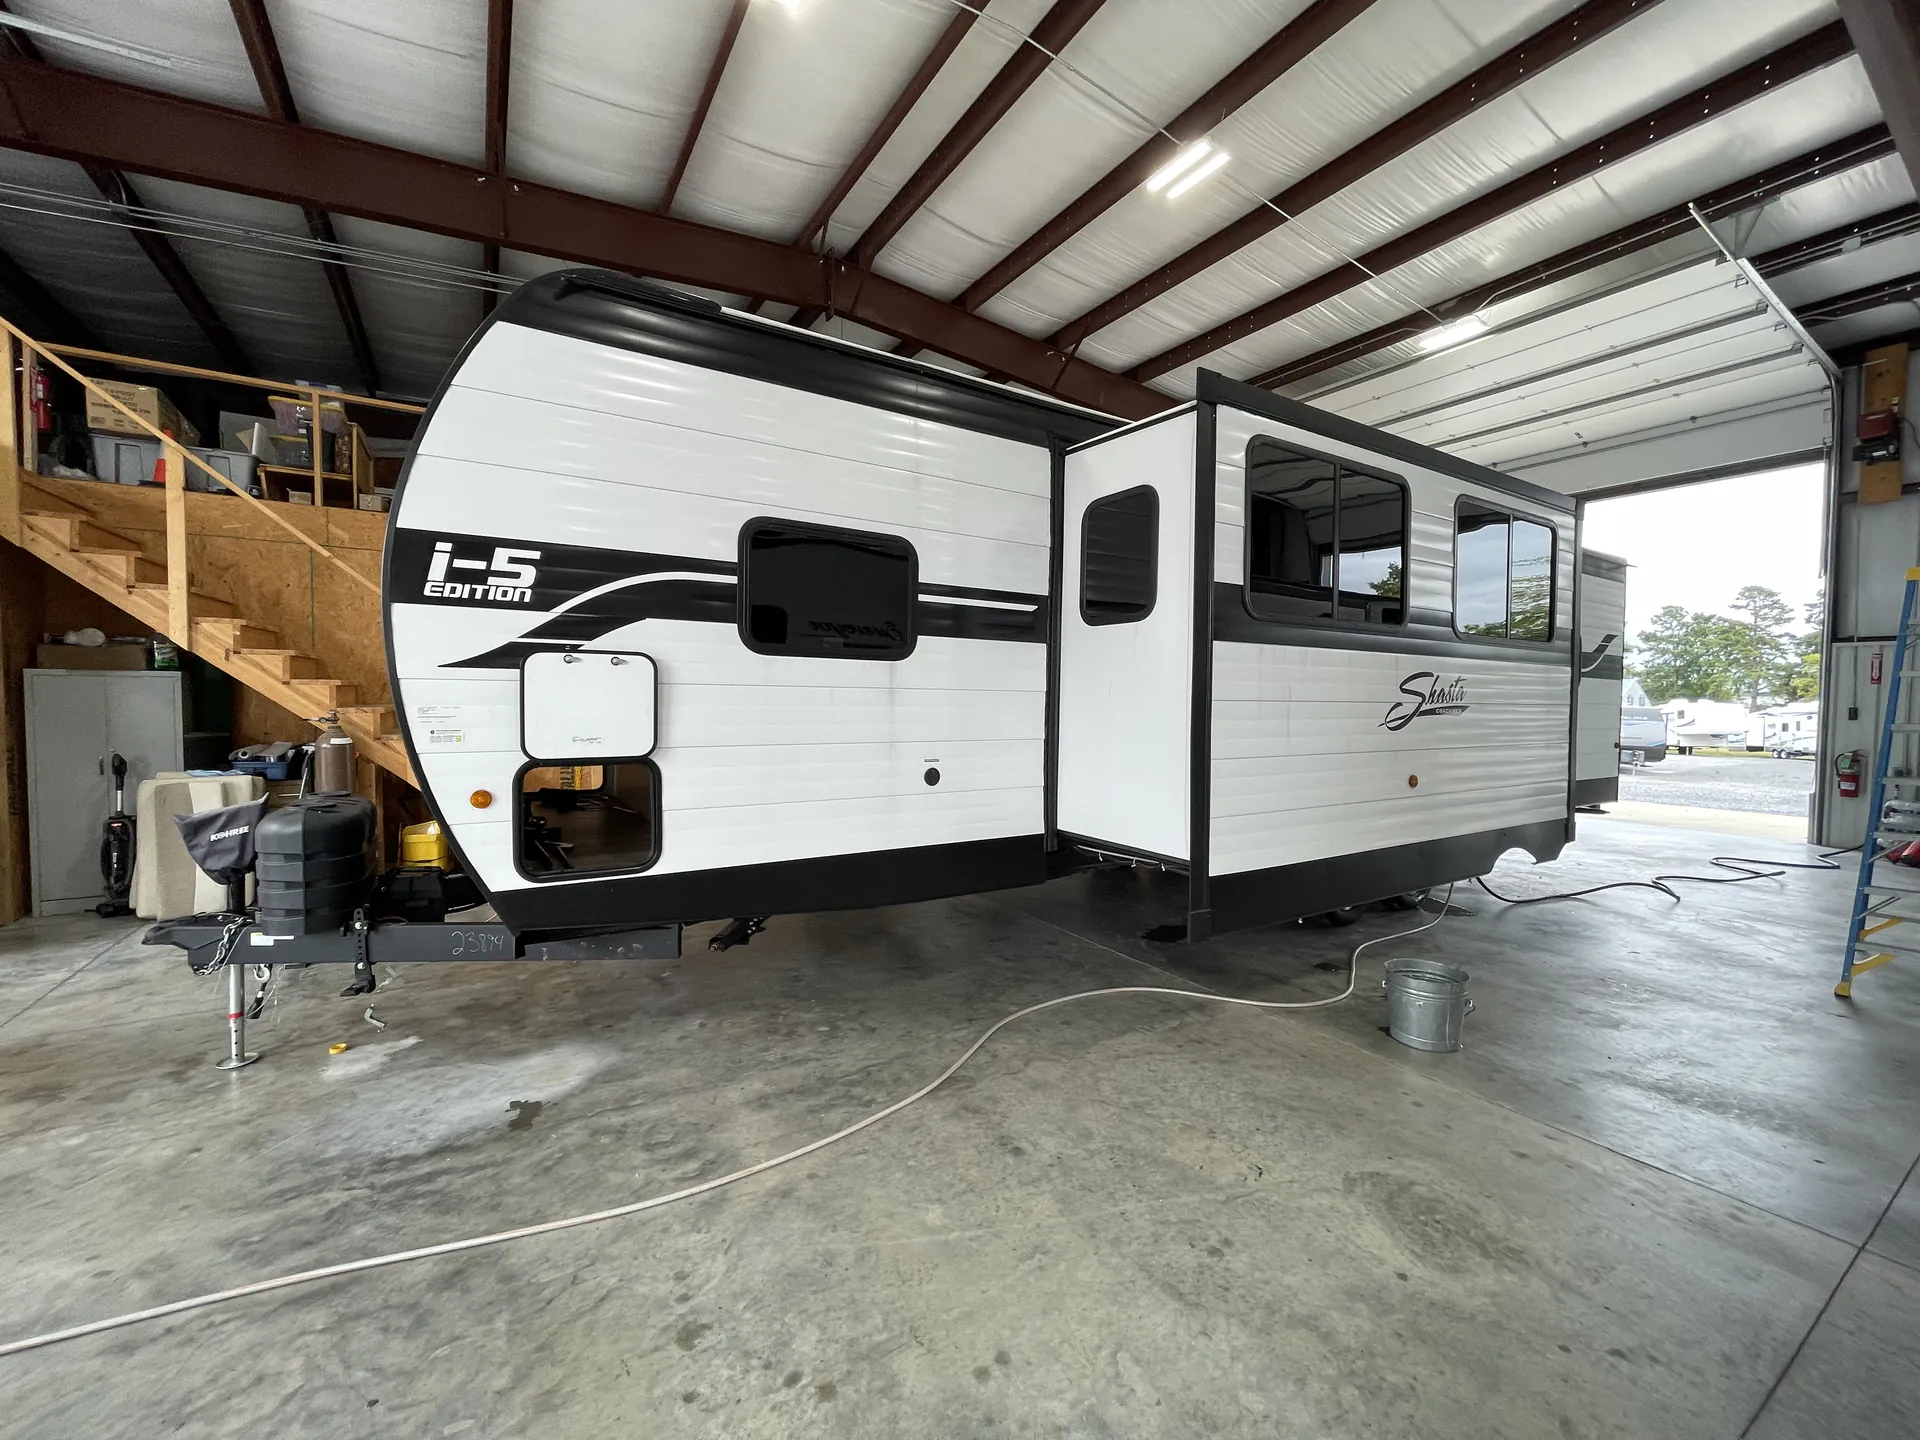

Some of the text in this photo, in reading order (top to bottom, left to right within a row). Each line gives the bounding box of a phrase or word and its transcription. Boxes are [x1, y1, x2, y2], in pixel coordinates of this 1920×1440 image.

[427, 541, 541, 587] i-5
[424, 581, 532, 602] EDITION
[1382, 671, 1467, 731] Shasta
[210, 825, 250, 841] KOHREE
[451, 931, 504, 955] 23894
